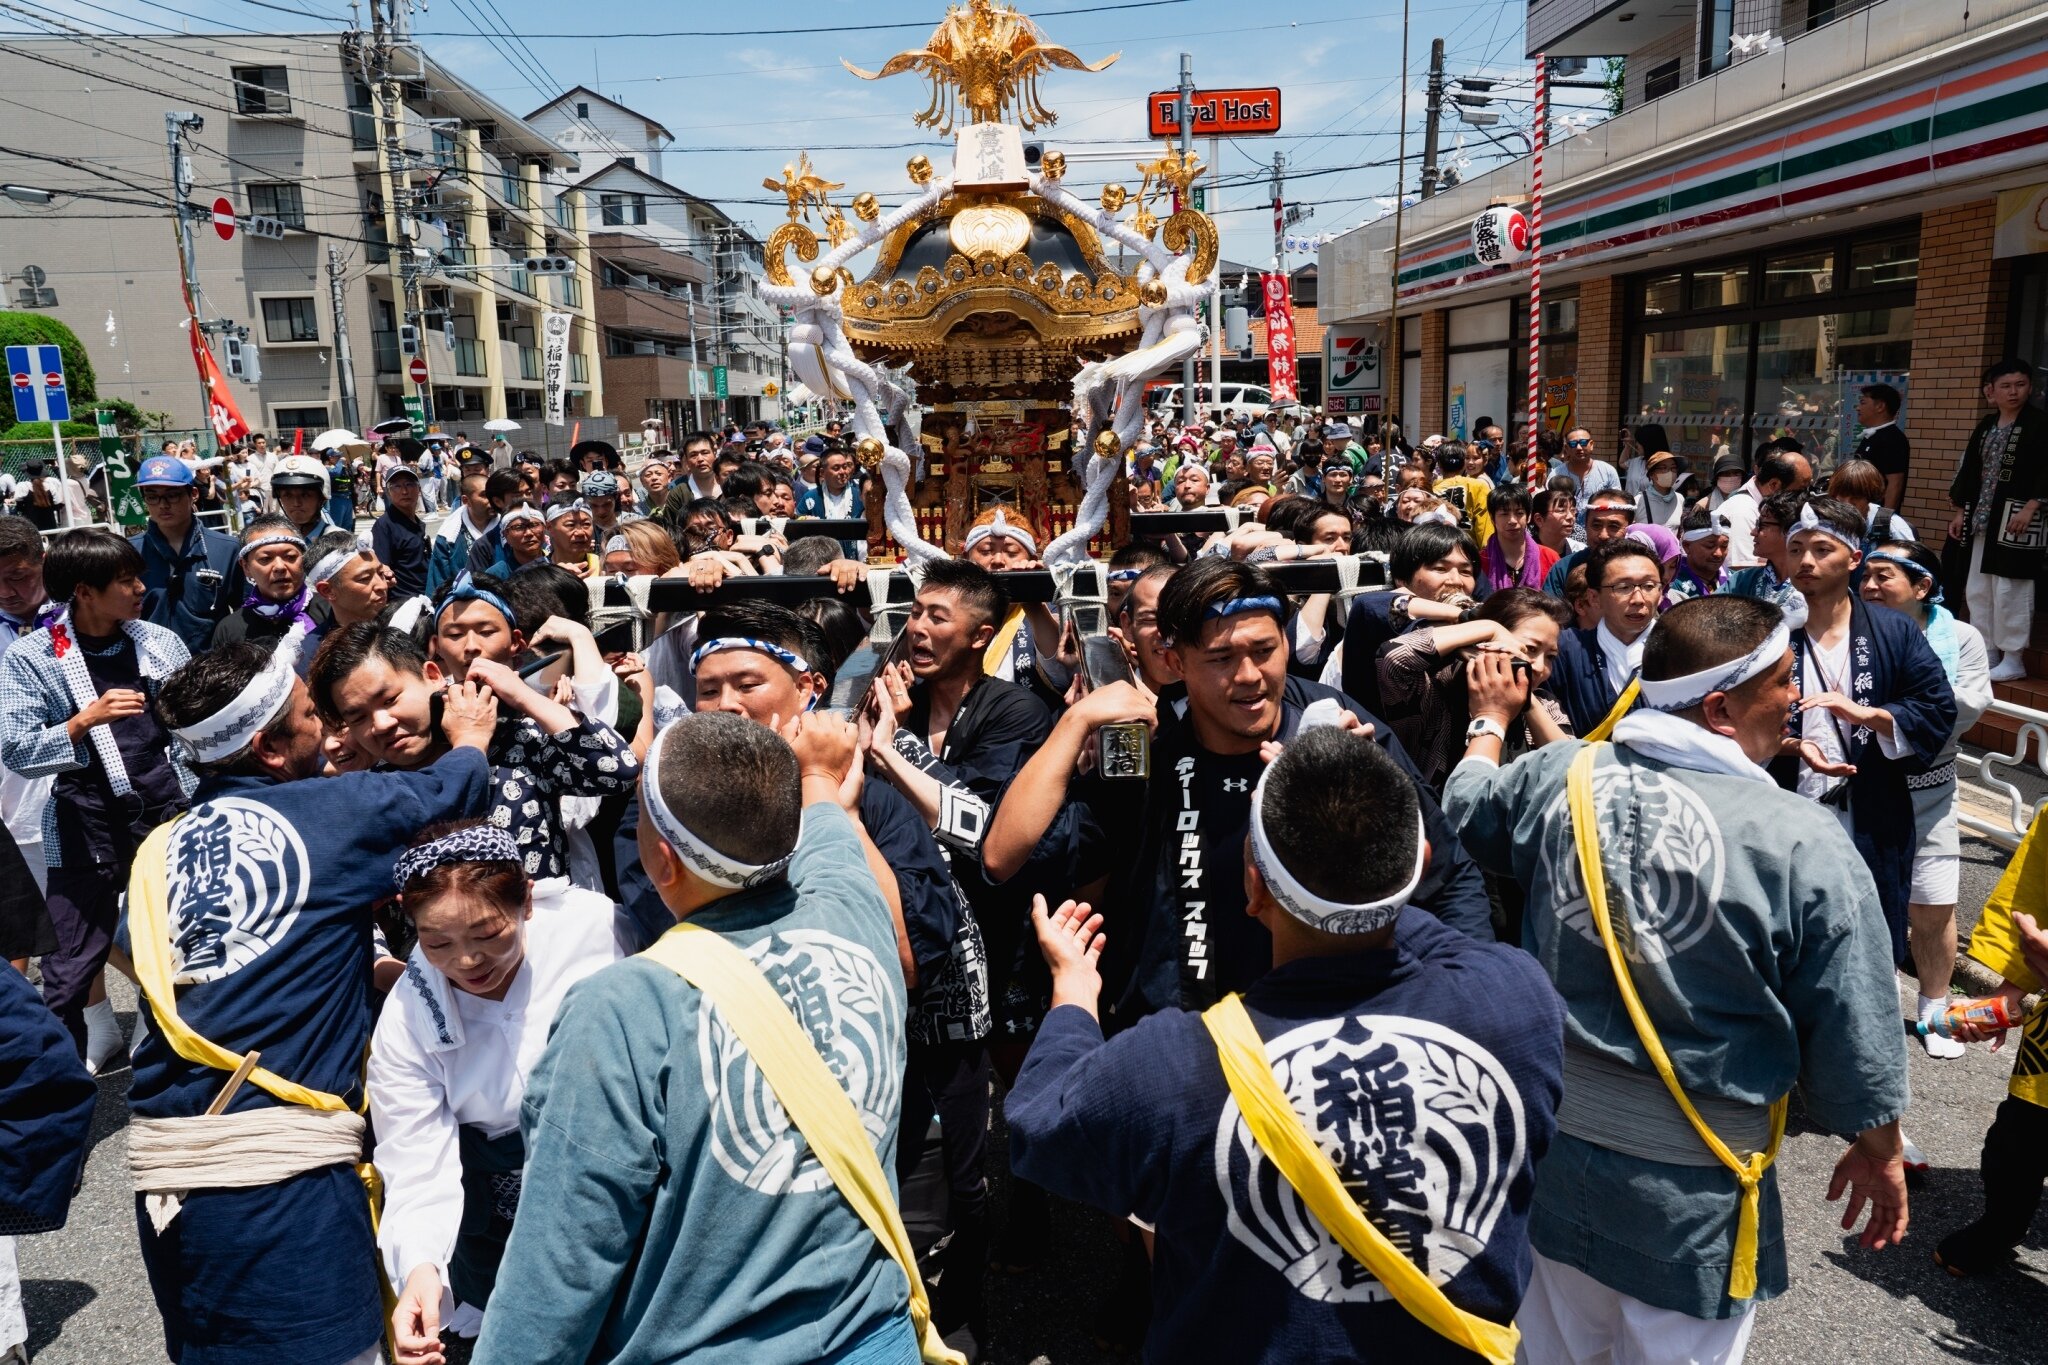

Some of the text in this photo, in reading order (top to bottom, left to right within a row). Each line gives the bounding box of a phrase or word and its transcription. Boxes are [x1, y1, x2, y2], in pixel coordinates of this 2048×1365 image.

[1159, 98, 1271, 125] Ryal Host
[1474, 212, 1502, 262] 御祭禮
[546, 345, 563, 413] 稲荷神社
[1328, 398, 1345, 411] たばこ
[1348, 398, 1360, 410] 酒
[1364, 397, 1380, 410] ATM
[1450, 404, 1463, 431] 夏
[1106, 729, 1144, 774] 稲荷
[1174, 756, 1209, 980] ティーロックス スタッフ
